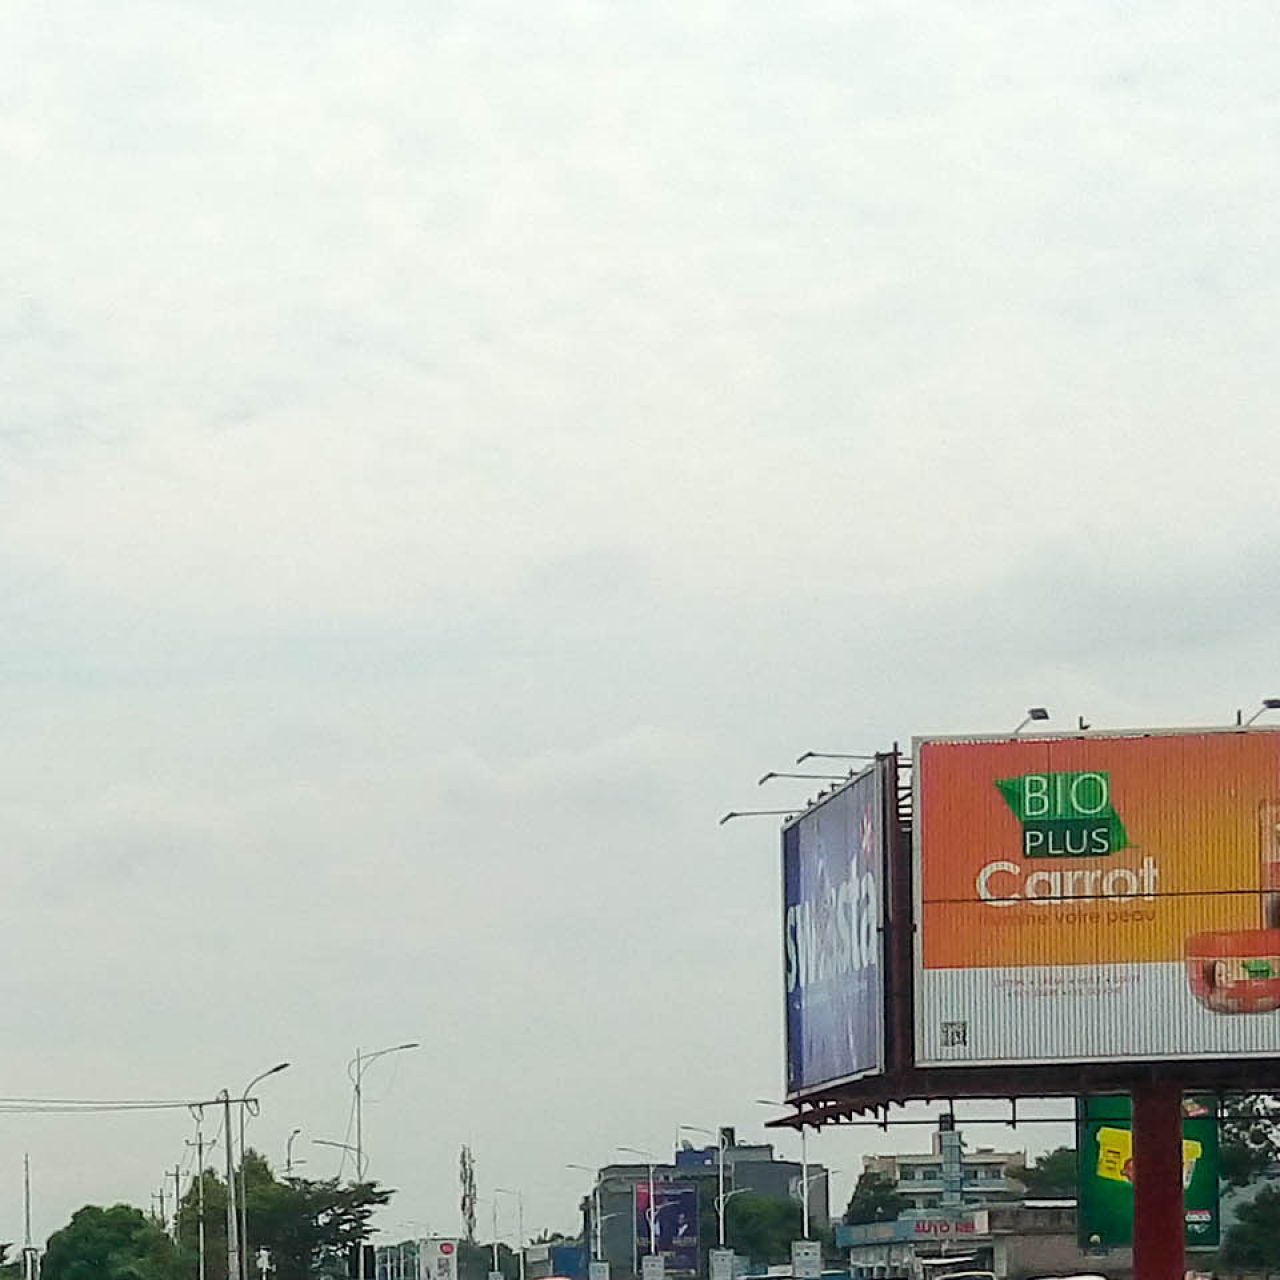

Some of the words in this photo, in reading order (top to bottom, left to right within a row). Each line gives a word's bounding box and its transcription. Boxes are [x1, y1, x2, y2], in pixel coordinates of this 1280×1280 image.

[1024, 773, 1109, 817] BIO
[1025, 827, 1110, 856] PLUS
[976, 856, 1159, 908] Carrot
